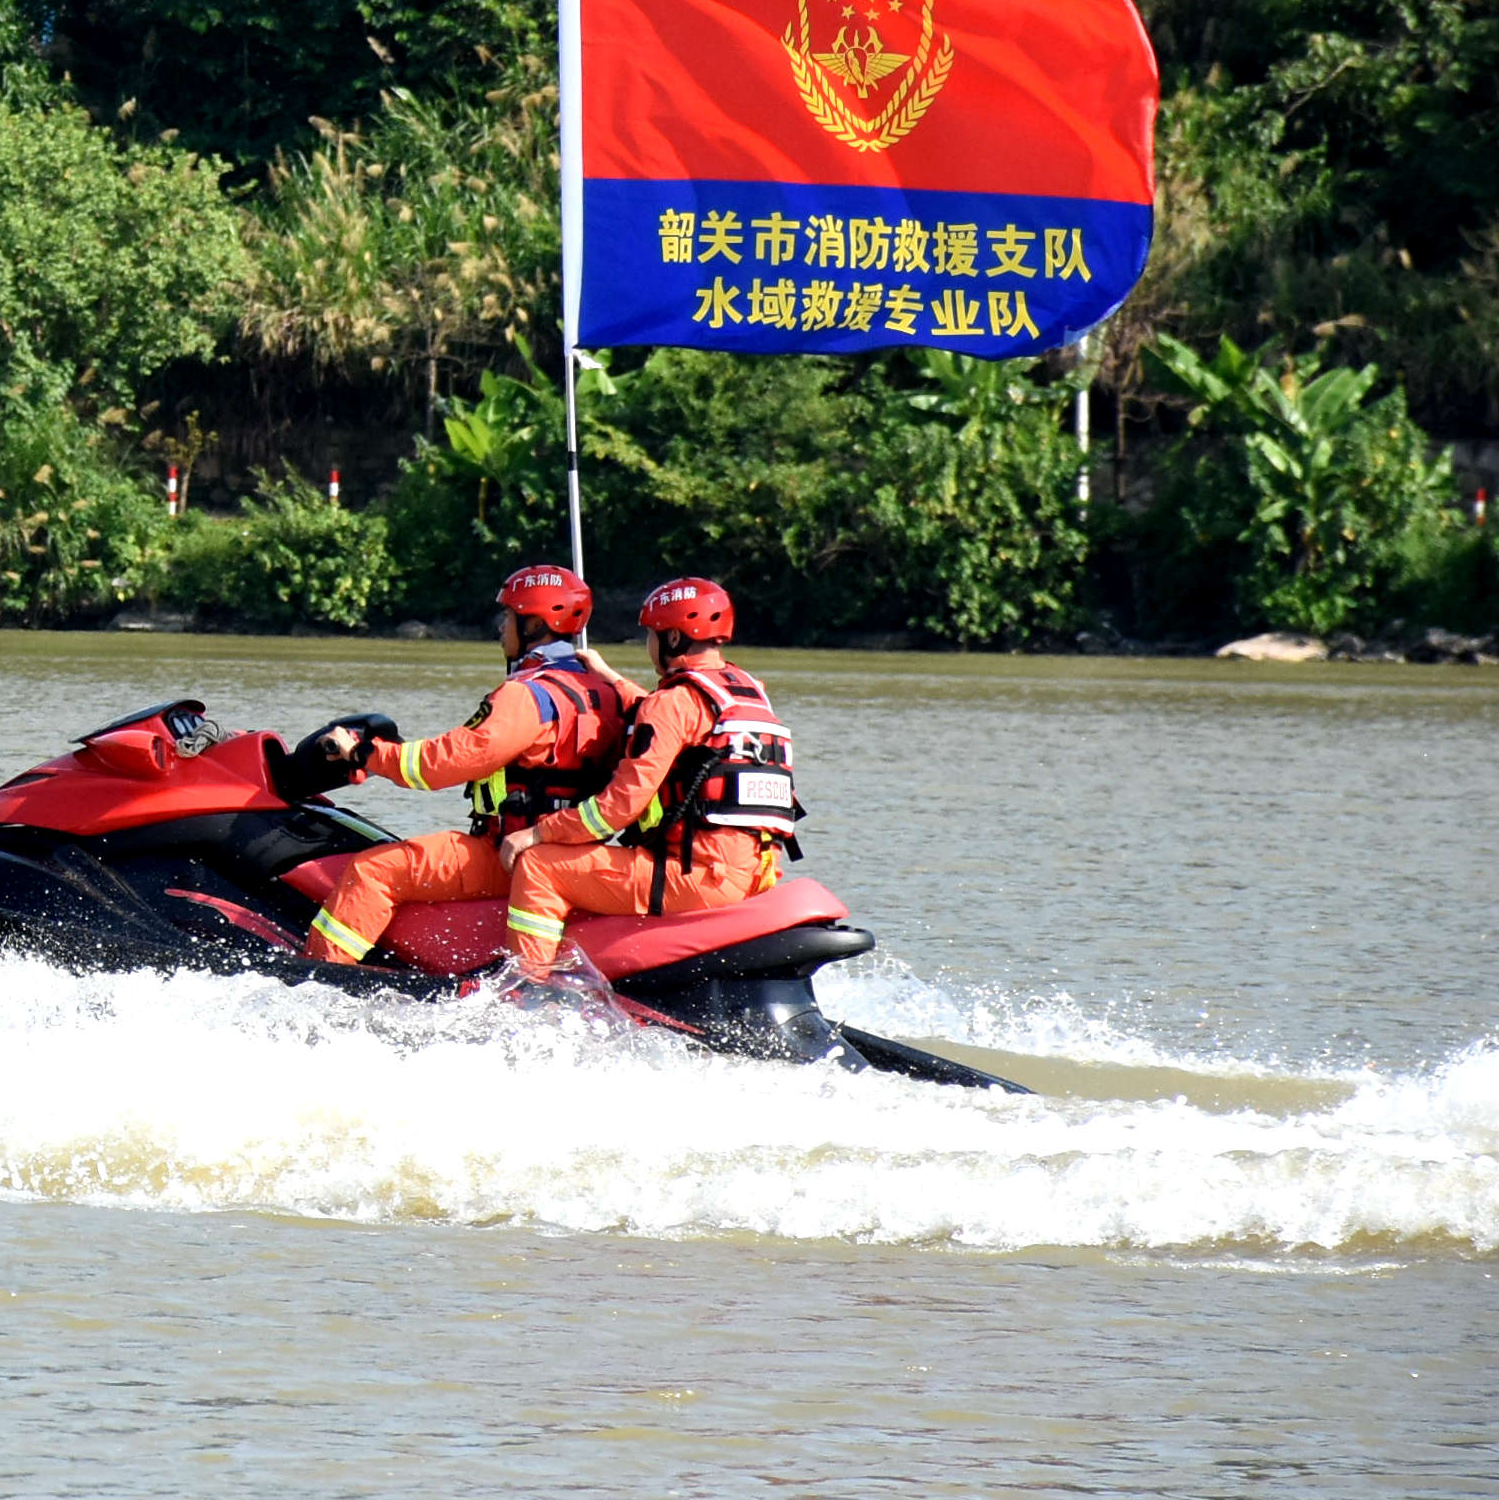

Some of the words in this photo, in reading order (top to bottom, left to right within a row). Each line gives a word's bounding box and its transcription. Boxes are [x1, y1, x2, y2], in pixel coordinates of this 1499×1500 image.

[658, 208, 1093, 283] 韶关市消防救援支队
[692, 276, 1041, 340] 水域救援专业队
[512, 573, 563, 592] 广东消防
[649, 586, 697, 612] 广东消防
